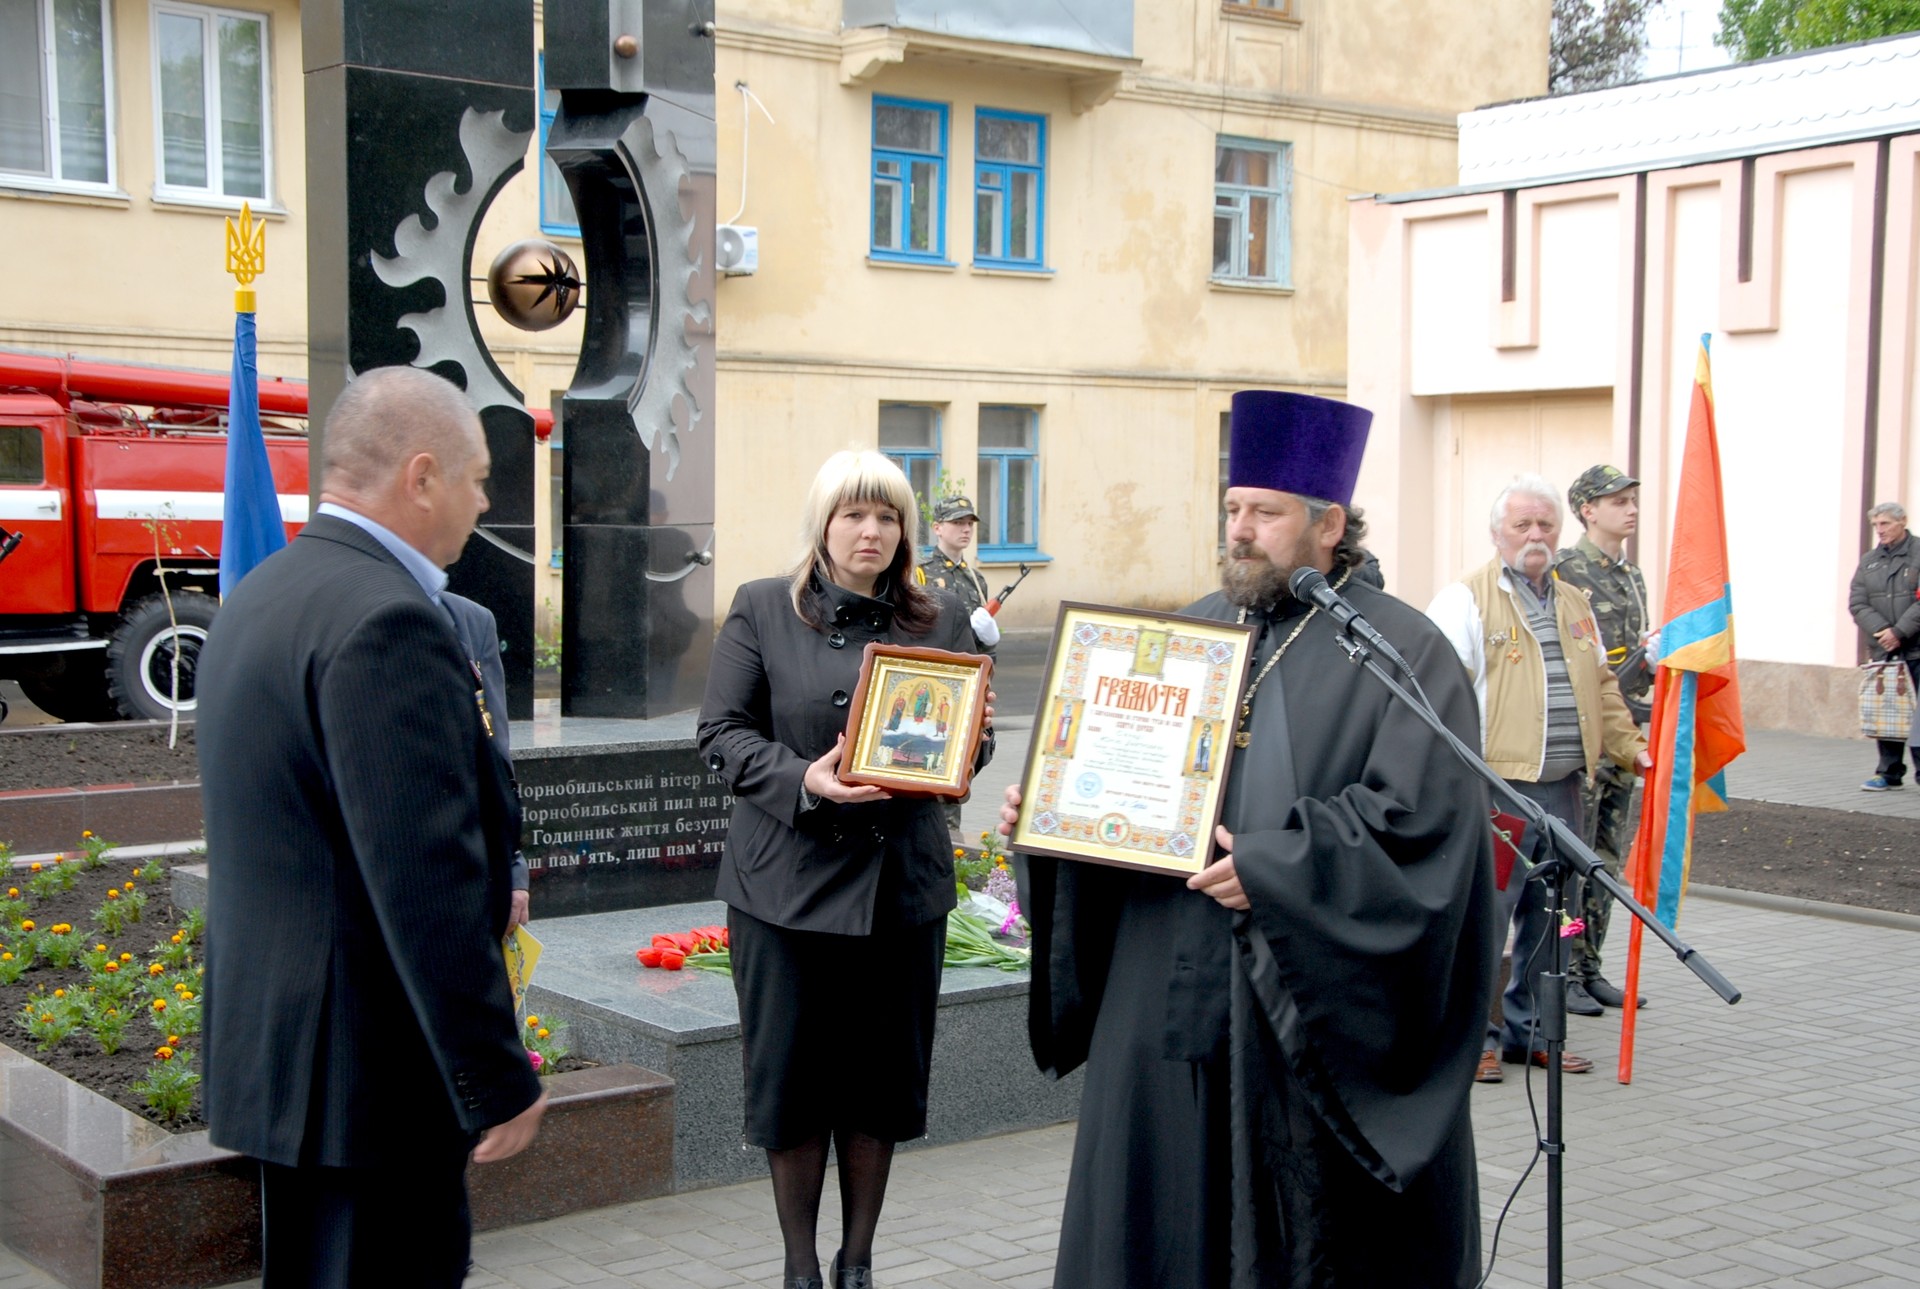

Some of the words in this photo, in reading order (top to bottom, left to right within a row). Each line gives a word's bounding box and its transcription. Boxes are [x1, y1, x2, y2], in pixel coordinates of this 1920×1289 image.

[1093, 676, 1191, 717] ГРАМОТА
[660, 772, 700, 790] вітер
[664, 798, 693, 810] пил
[699, 796, 717, 808] на
[532, 827, 615, 846] Годинник
[620, 823, 670, 838] життя
[626, 846, 660, 861] лиш
